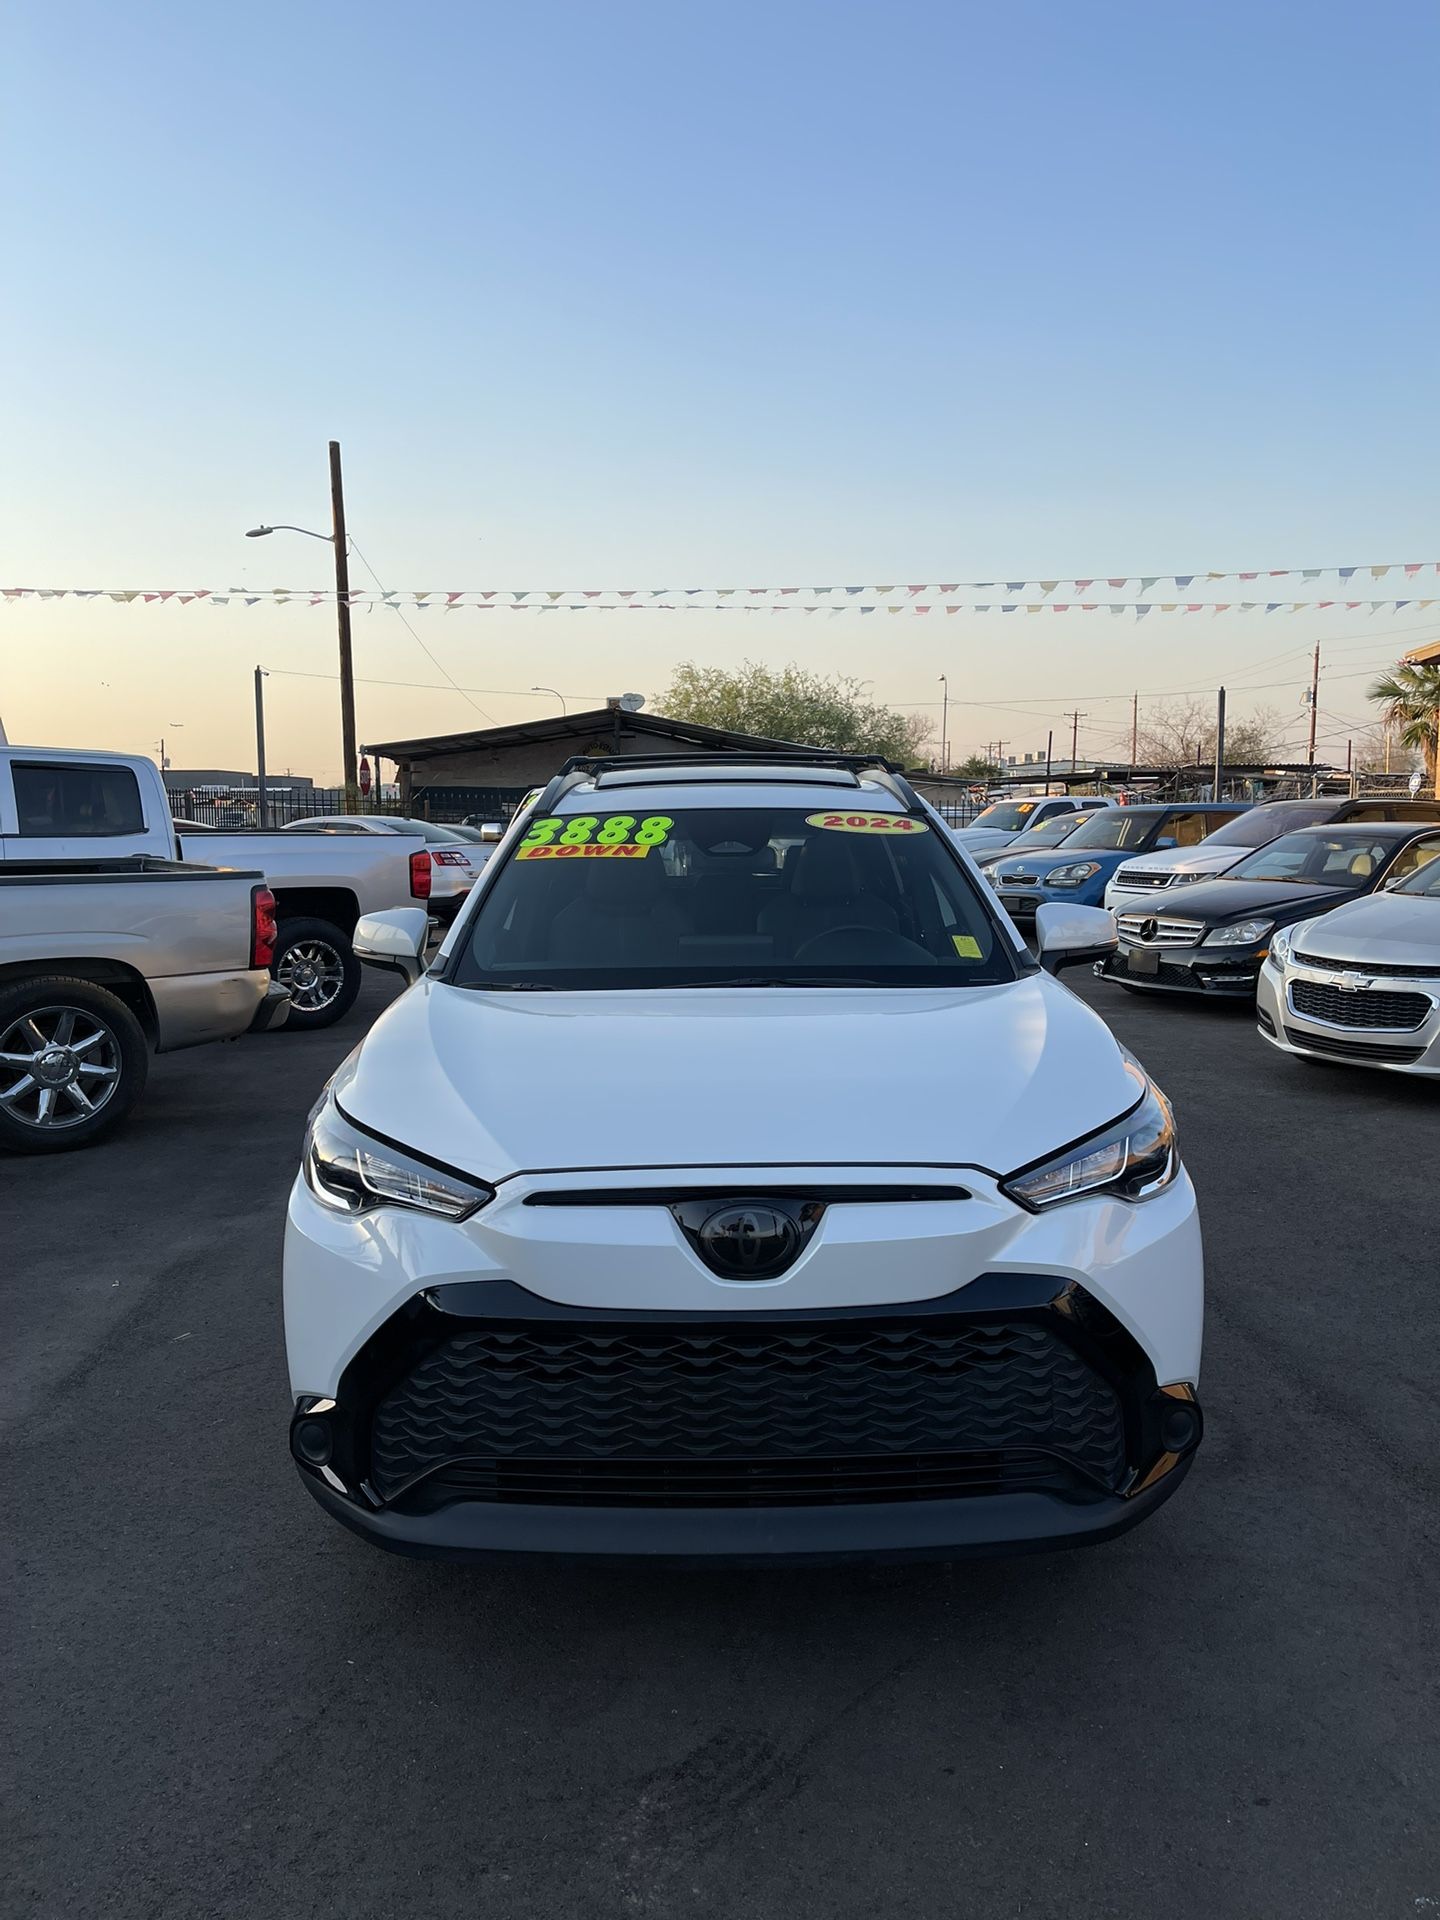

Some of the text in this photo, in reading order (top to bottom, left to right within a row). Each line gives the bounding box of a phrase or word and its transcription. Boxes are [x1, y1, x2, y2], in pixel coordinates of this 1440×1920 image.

[520, 815, 675, 847] 3888
[823, 815, 913, 831] 2024
[526, 844, 642, 858] DOWN
